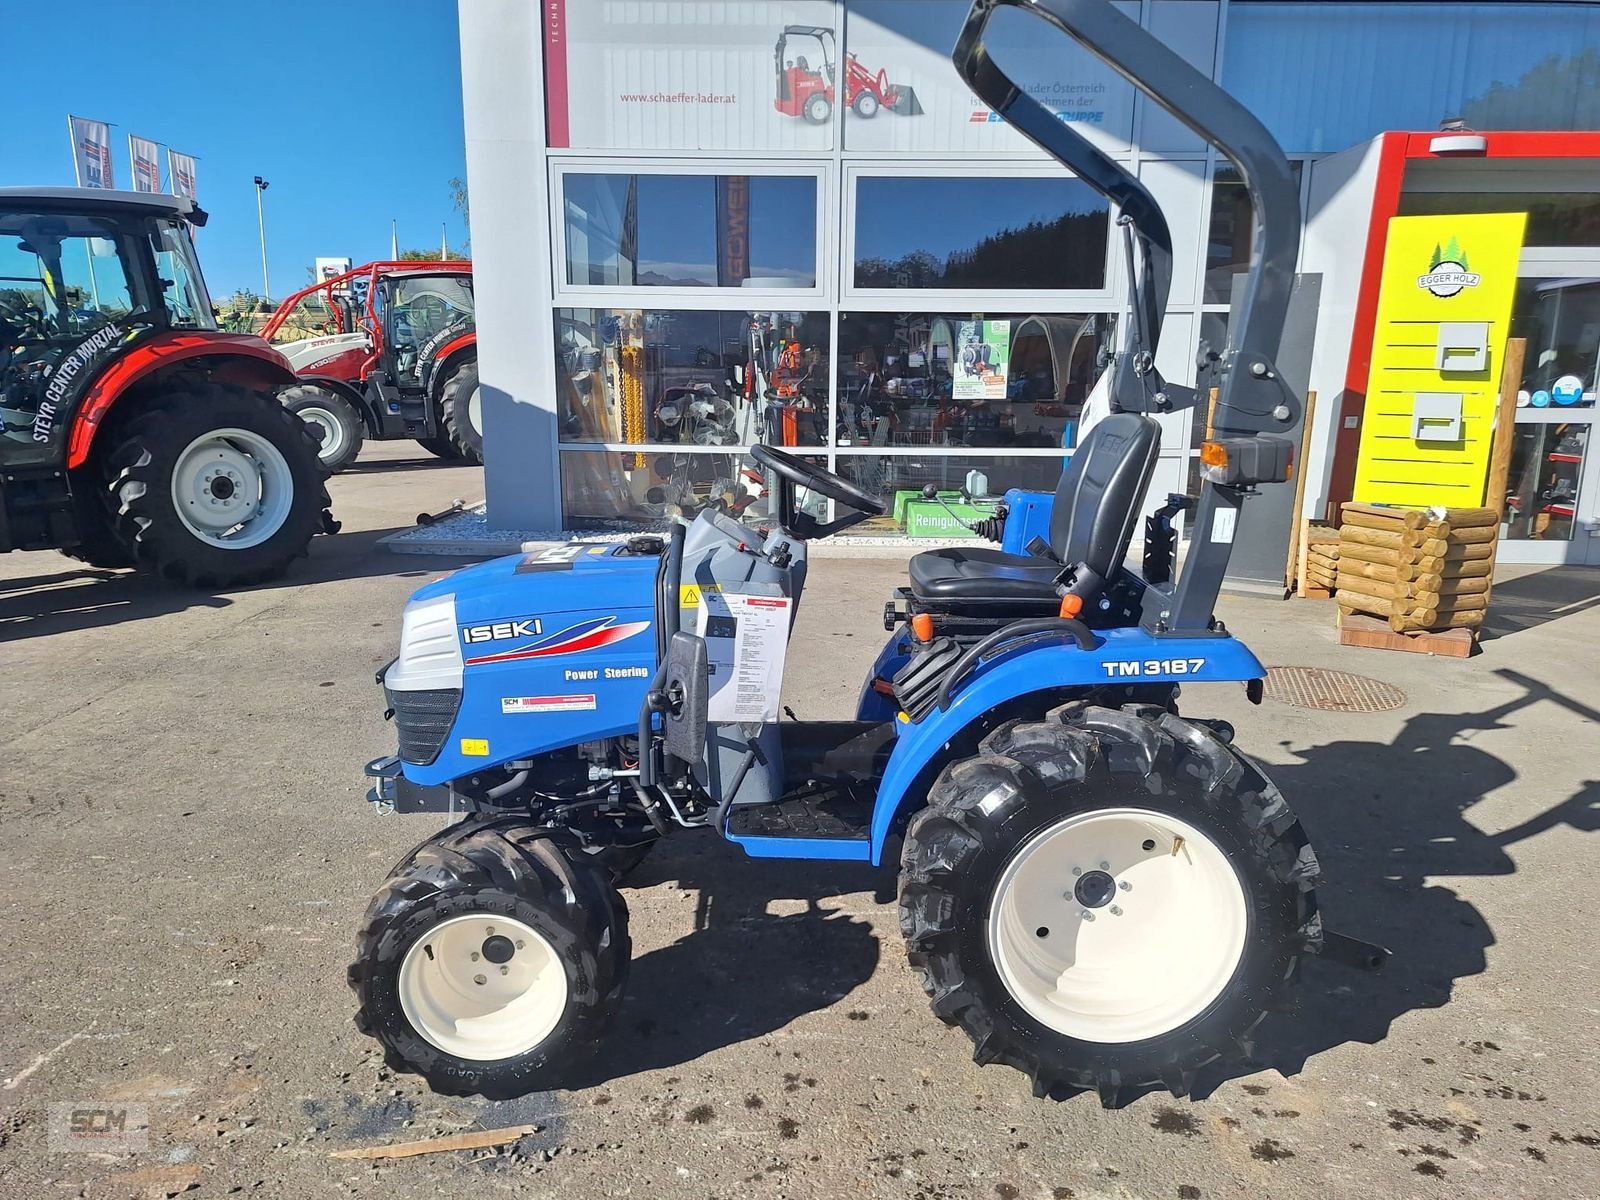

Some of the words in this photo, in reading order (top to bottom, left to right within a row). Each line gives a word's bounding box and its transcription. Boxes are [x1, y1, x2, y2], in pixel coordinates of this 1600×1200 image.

[620, 93, 736, 104] www.schaeffer-lader.at
[1074, 97, 1094, 106] der
[1420, 274, 1451, 286] EGGER
[1453, 274, 1477, 284] HOLZ
[33, 402, 57, 443] STEYR
[45, 356, 82, 402] CENTER
[76, 323, 123, 362] MURTAL
[463, 618, 543, 644] ISEKI
[565, 669, 598, 681] Power
[604, 667, 648, 679] Steering
[1102, 661, 1140, 677] TM
[1144, 658, 1205, 675] 3187
